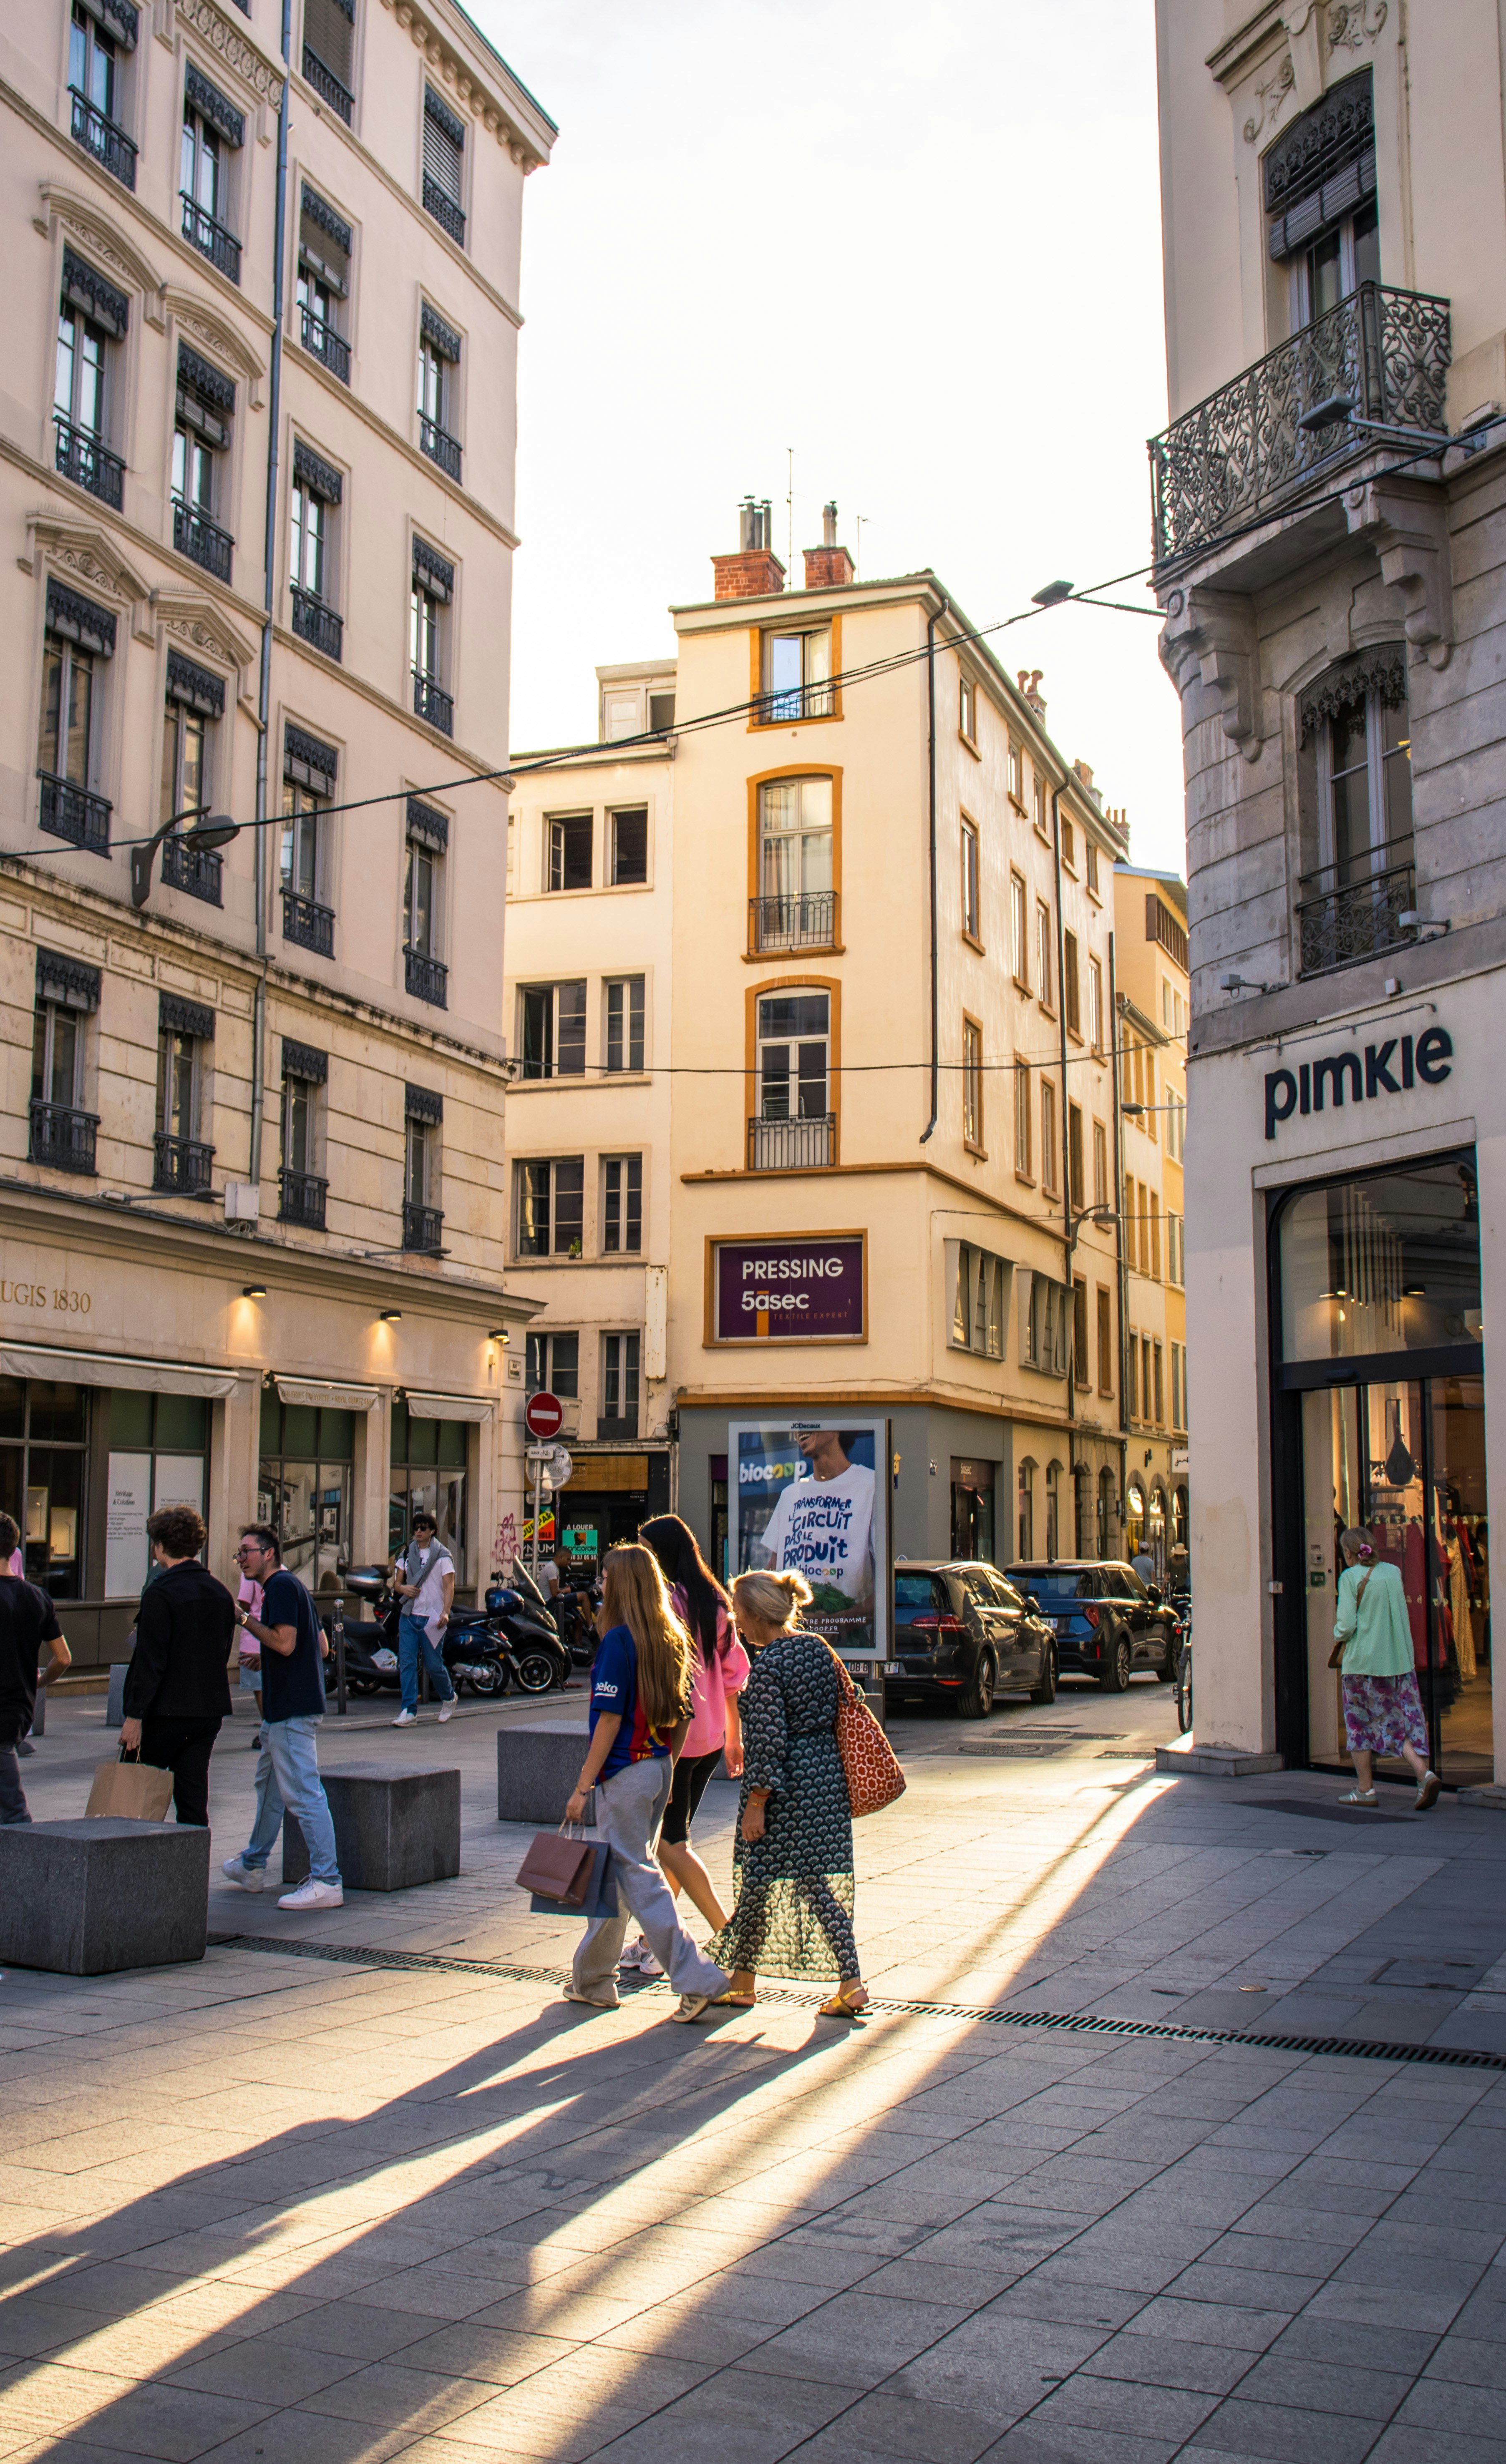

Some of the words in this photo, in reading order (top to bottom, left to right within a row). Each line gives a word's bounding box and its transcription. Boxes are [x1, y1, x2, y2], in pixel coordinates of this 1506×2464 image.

[1264, 1027, 1453, 1139] pimkie
[743, 1257, 844, 1280] PRESSING
[0, 1280, 46, 1307] UGIS
[53, 1288, 91, 1313] 1830
[739, 1461, 807, 1483] biocoop
[793, 1496, 852, 1512] TRANSFORMER
[788, 1512, 796, 1522] LE
[784, 1530, 802, 1550] PAS
[803, 1531, 813, 1541] LE
